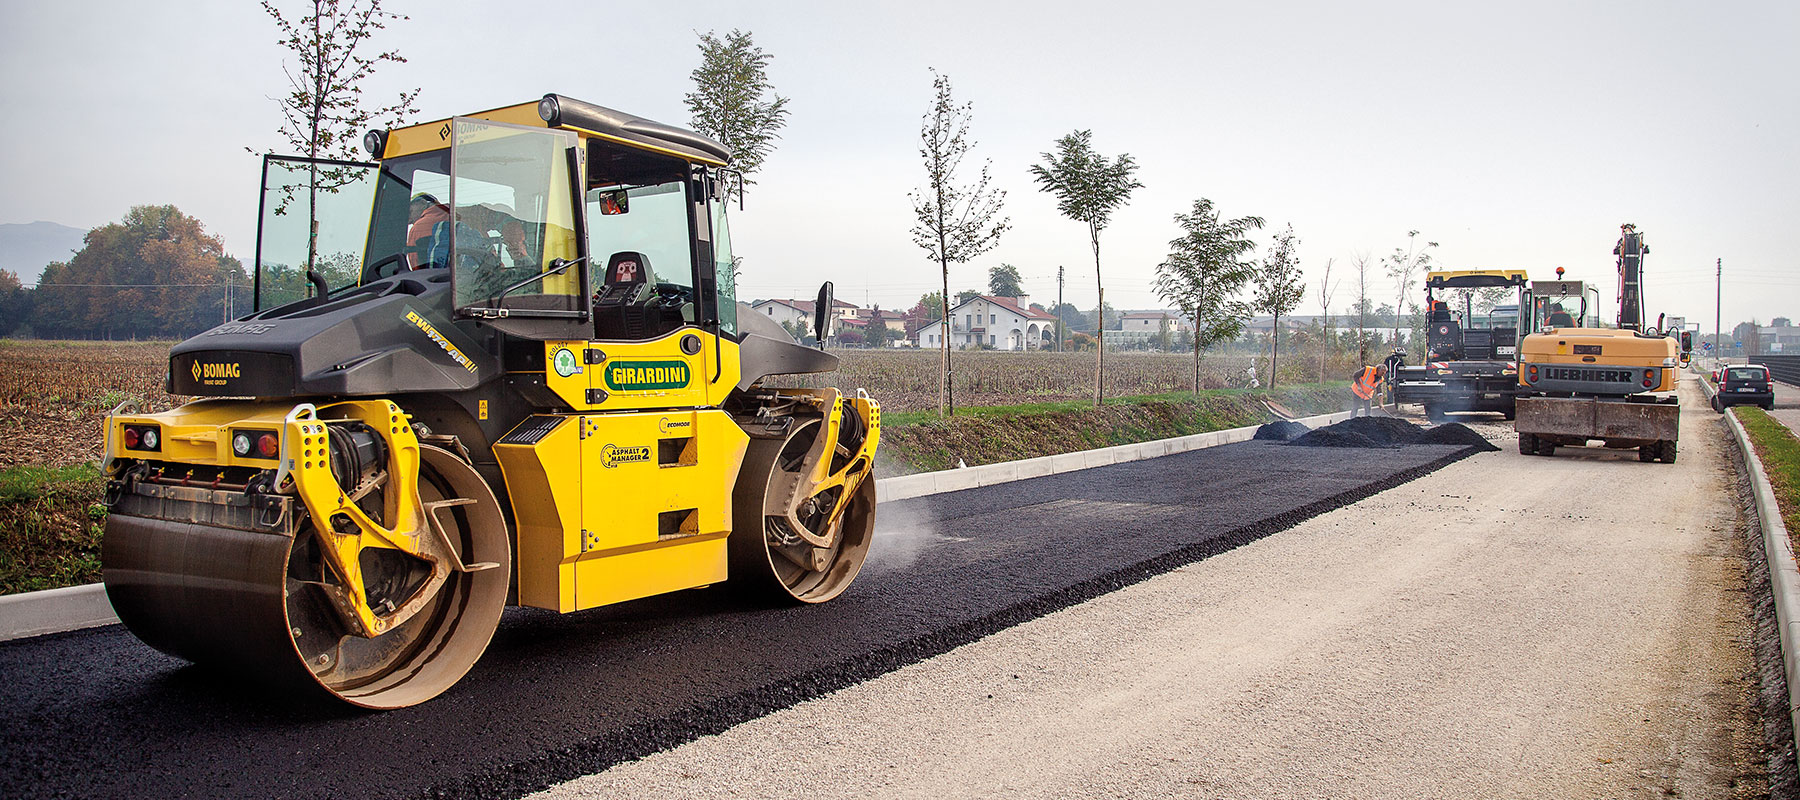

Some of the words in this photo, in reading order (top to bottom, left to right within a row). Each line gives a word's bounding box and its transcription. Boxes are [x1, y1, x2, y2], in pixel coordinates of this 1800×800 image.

[457, 123, 488, 134] OMAG
[203, 362, 241, 378] BOMAG
[612, 366, 686, 385] GIRARDINI
[1545, 368, 1633, 383] LIEBHERR
[611, 448, 640, 456] ASPHALT
[641, 447, 650, 460] 2
